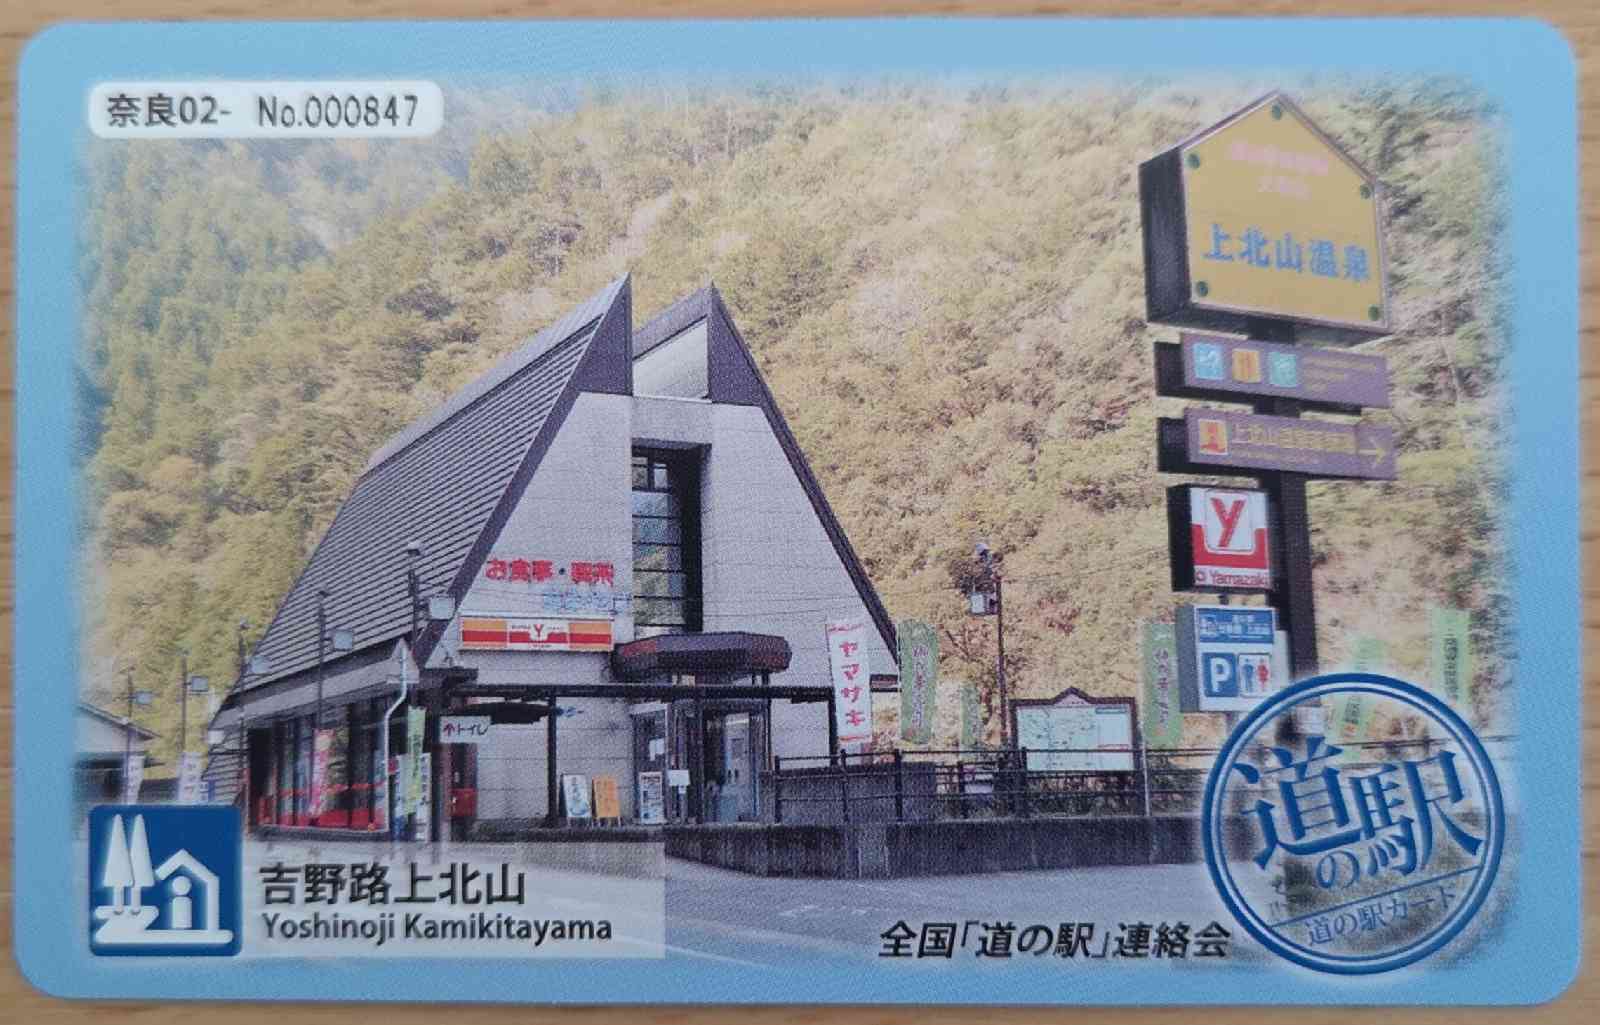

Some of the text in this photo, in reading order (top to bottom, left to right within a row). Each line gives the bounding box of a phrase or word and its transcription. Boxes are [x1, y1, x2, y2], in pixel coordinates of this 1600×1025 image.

[106, 93, 419, 127] 奈良02- No.000847
[838, 640, 865, 727] ヤマザキ
[1210, 657, 1229, 693] P
[1232, 736, 1485, 888] 道の駅
[259, 862, 526, 905] 吉野路上北山
[261, 912, 612, 947] Yoshinoji Kamikitayama
[879, 920, 1232, 959] 全国「道の駅」連絡会
